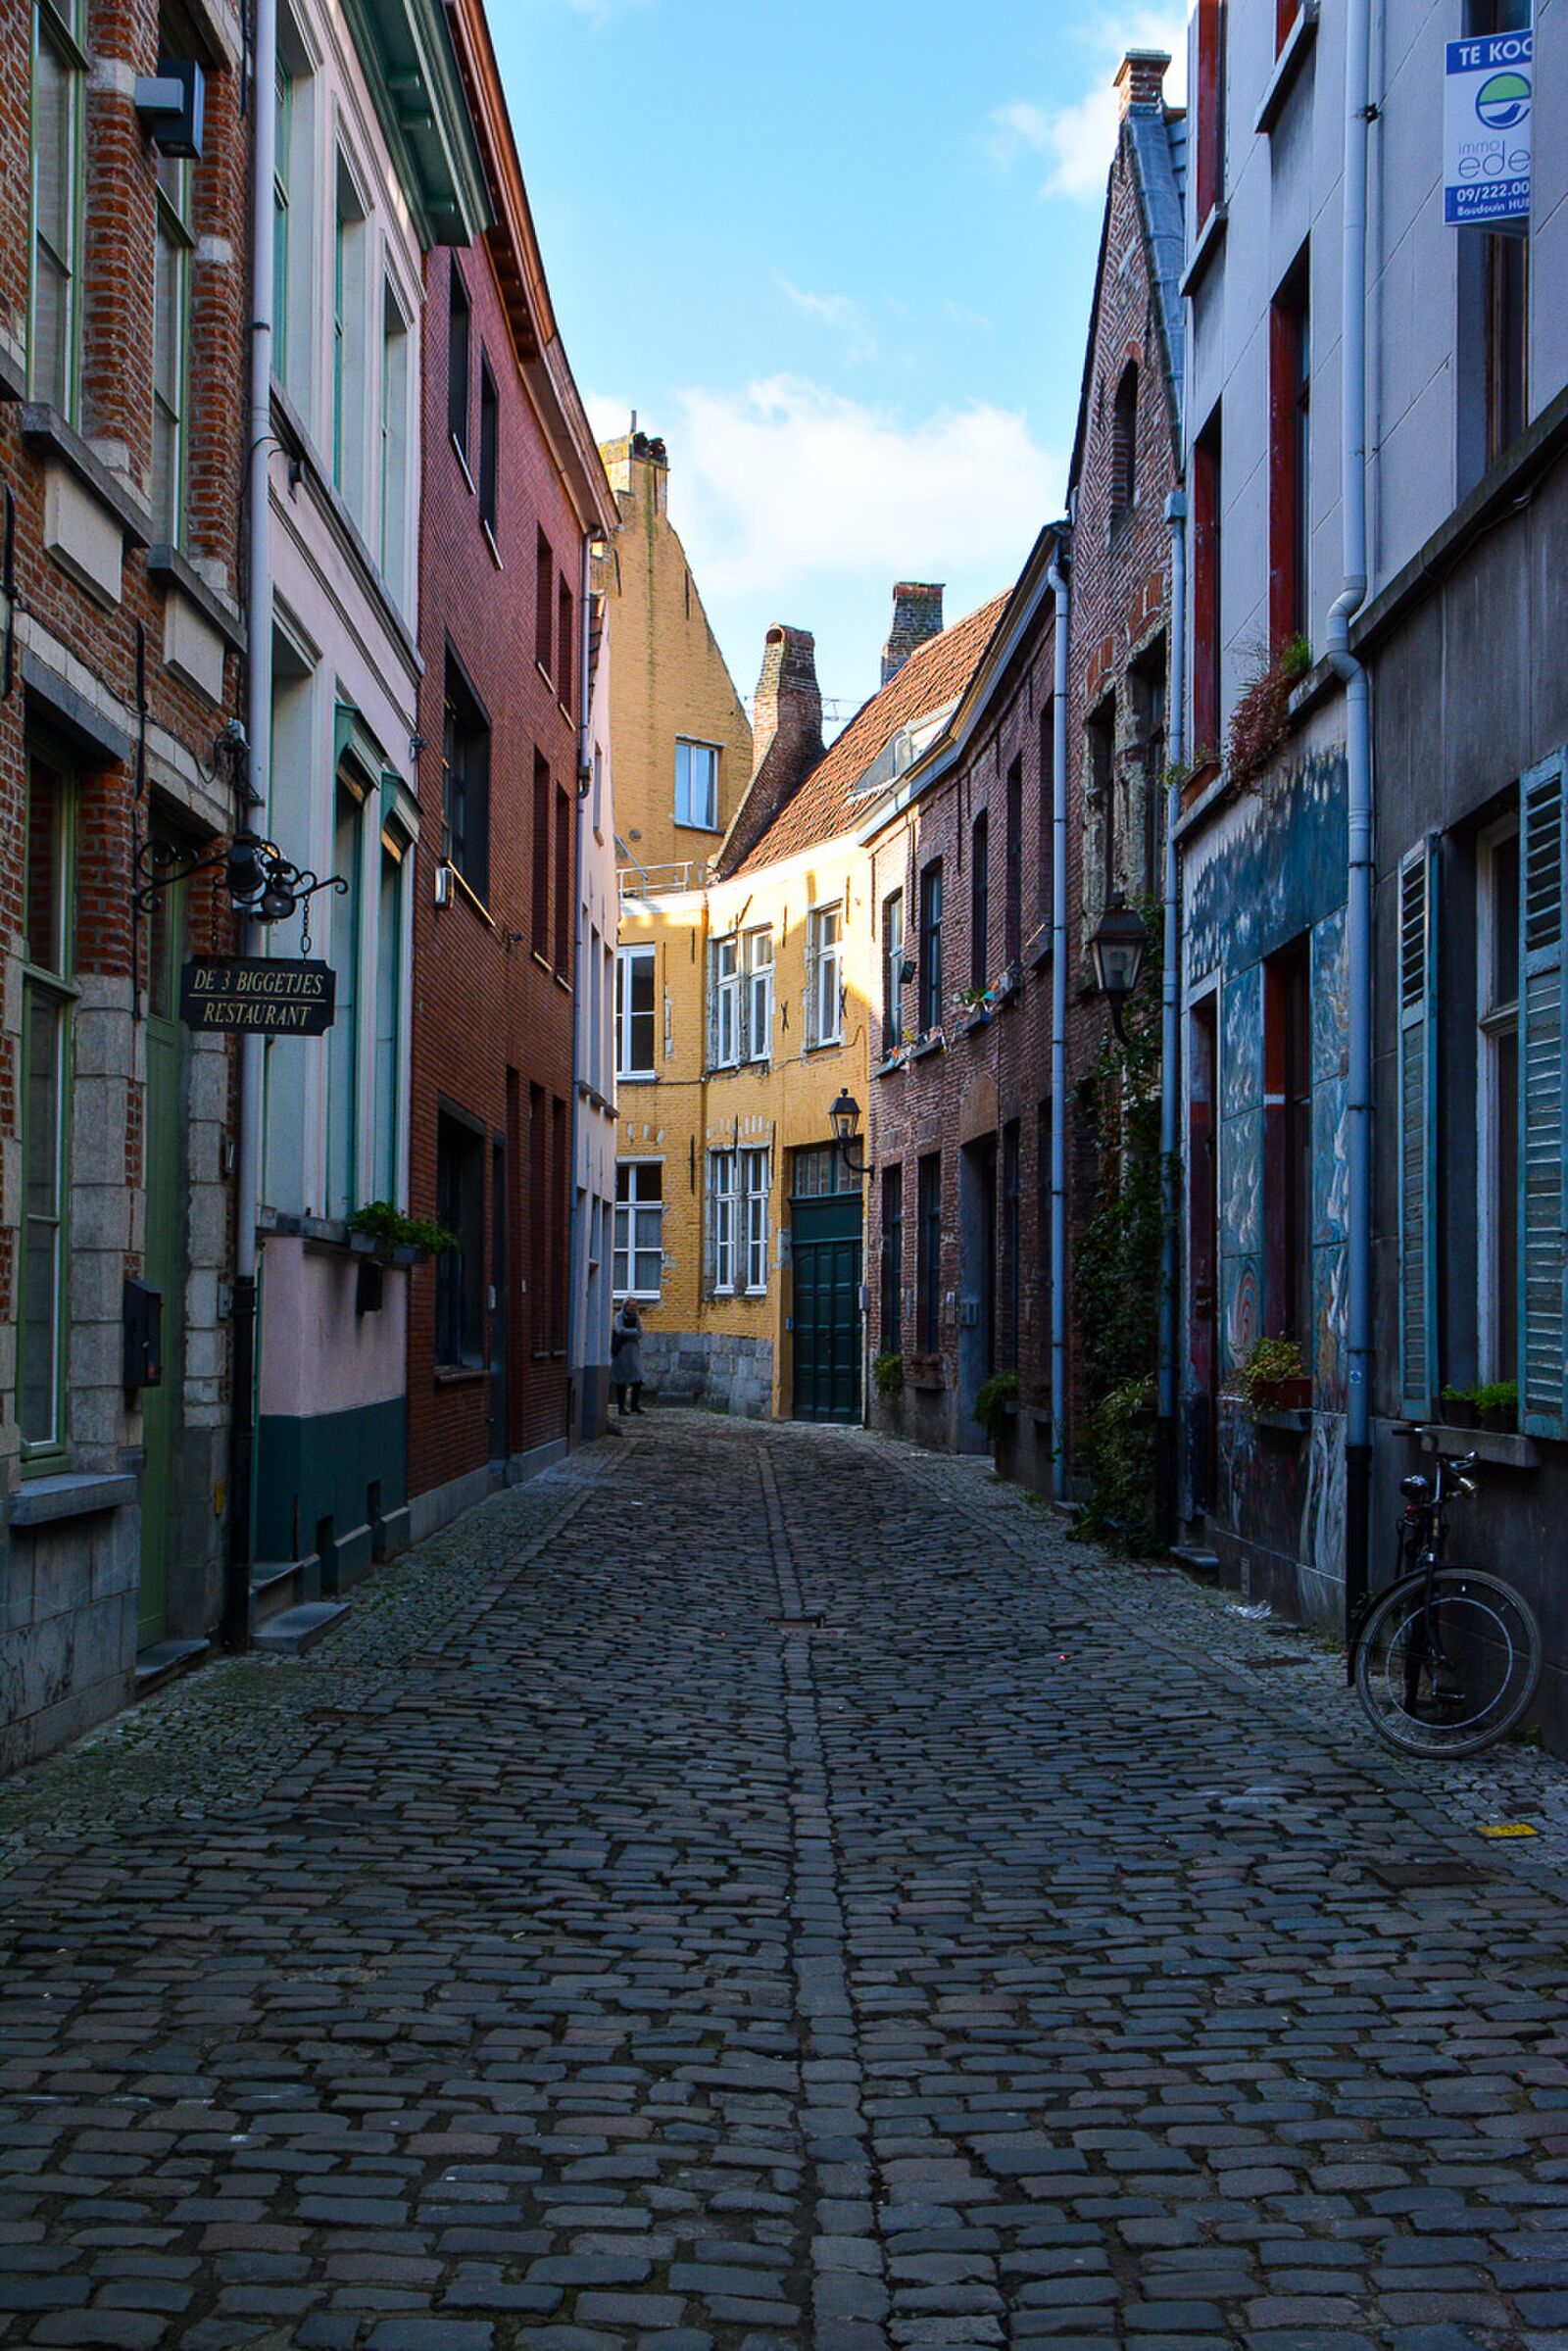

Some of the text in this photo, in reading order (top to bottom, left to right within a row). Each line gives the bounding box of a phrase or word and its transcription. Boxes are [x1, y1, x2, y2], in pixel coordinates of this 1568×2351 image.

[1458, 45, 1481, 66] TE
[1459, 140, 1500, 156] immo
[1456, 181, 1530, 203] 09/222.00
[194, 968, 324, 995] DE 3 BIGGETJES
[204, 1002, 313, 1027] RESTAURANT
